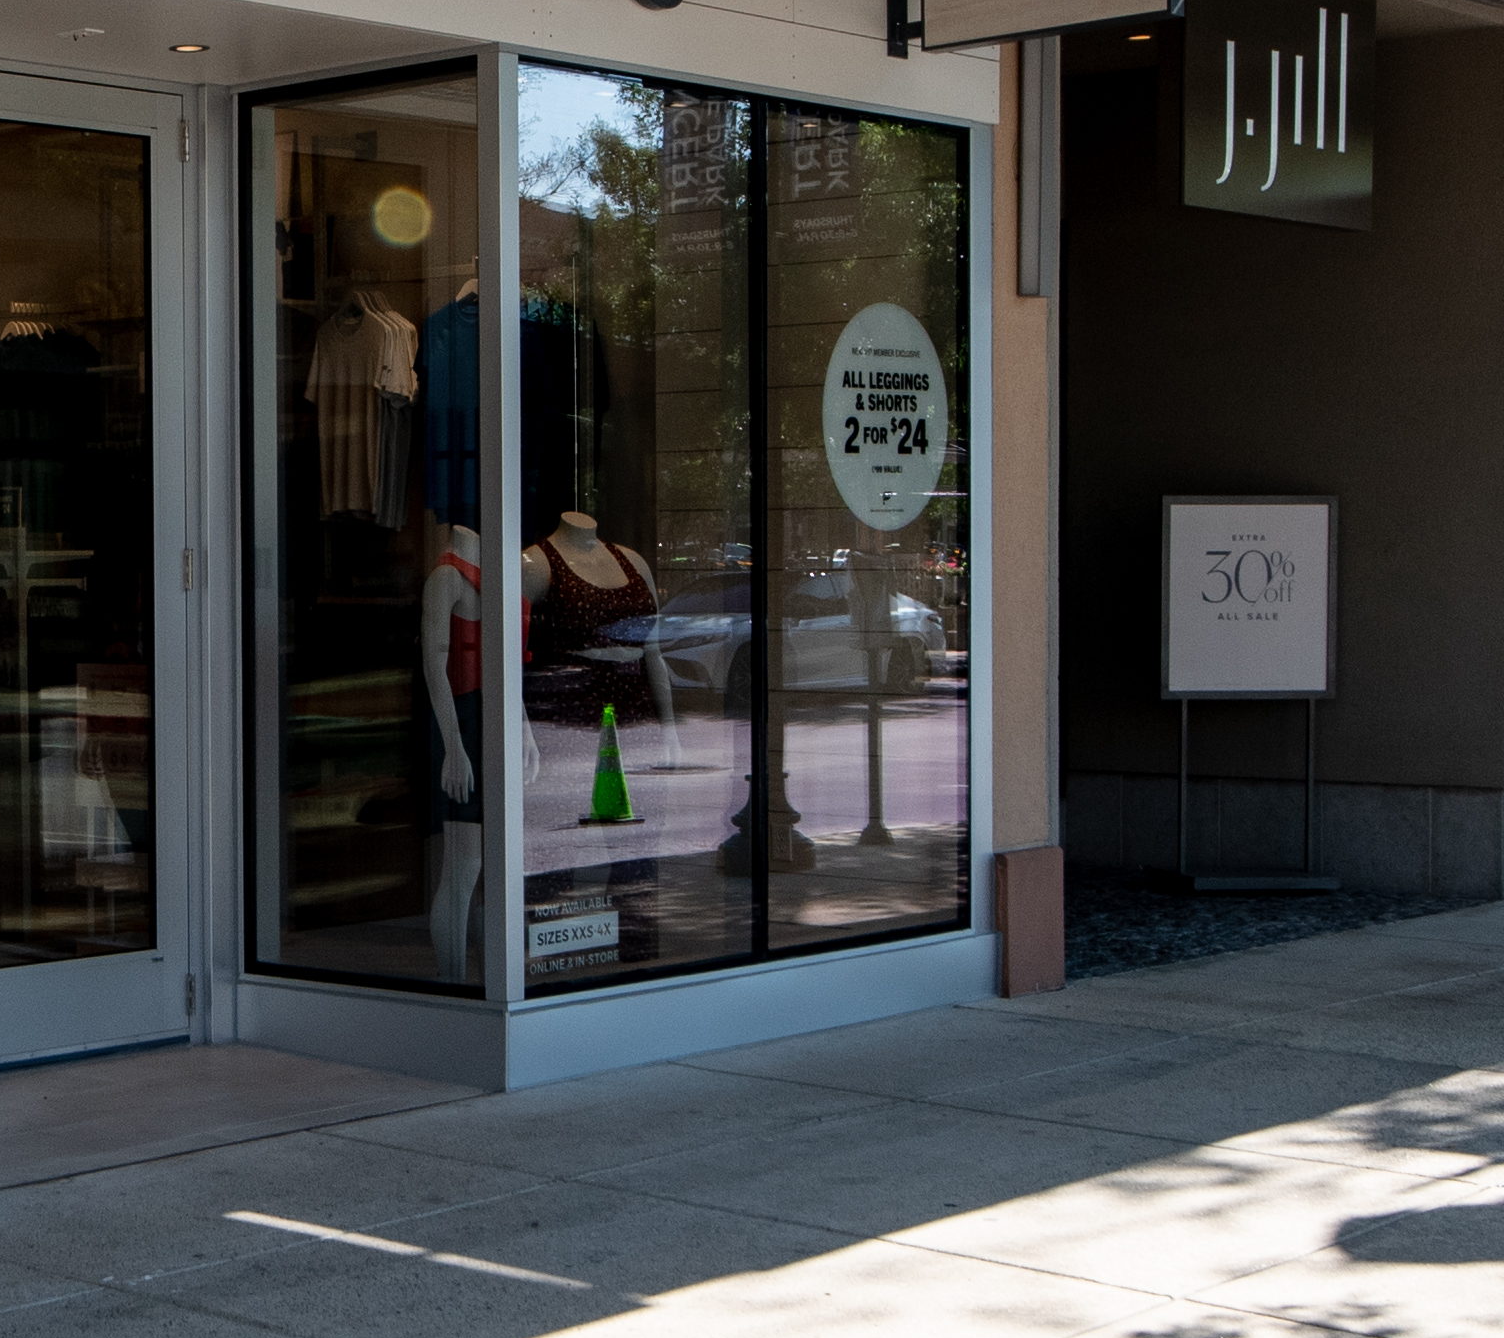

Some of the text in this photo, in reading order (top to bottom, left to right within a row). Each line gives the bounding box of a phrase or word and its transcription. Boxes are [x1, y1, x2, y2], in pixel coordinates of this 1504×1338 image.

[842, 370, 930, 391] ALL LEGGINGS
[855, 393, 918, 412] & SHORTS
[844, 416, 929, 455] 2 FOR $24
[1231, 534, 1266, 542] EXTRA
[1201, 549, 1295, 604] 30%
[1263, 578, 1295, 603] off
[1217, 612, 1279, 621] ALL SALE
[534, 896, 613, 918] NOW AVAILABLE
[537, 922, 612, 946] SIZES XXS-4X
[529, 960, 566, 976] ONLINE
[574, 950, 620, 968] IN-STORE
